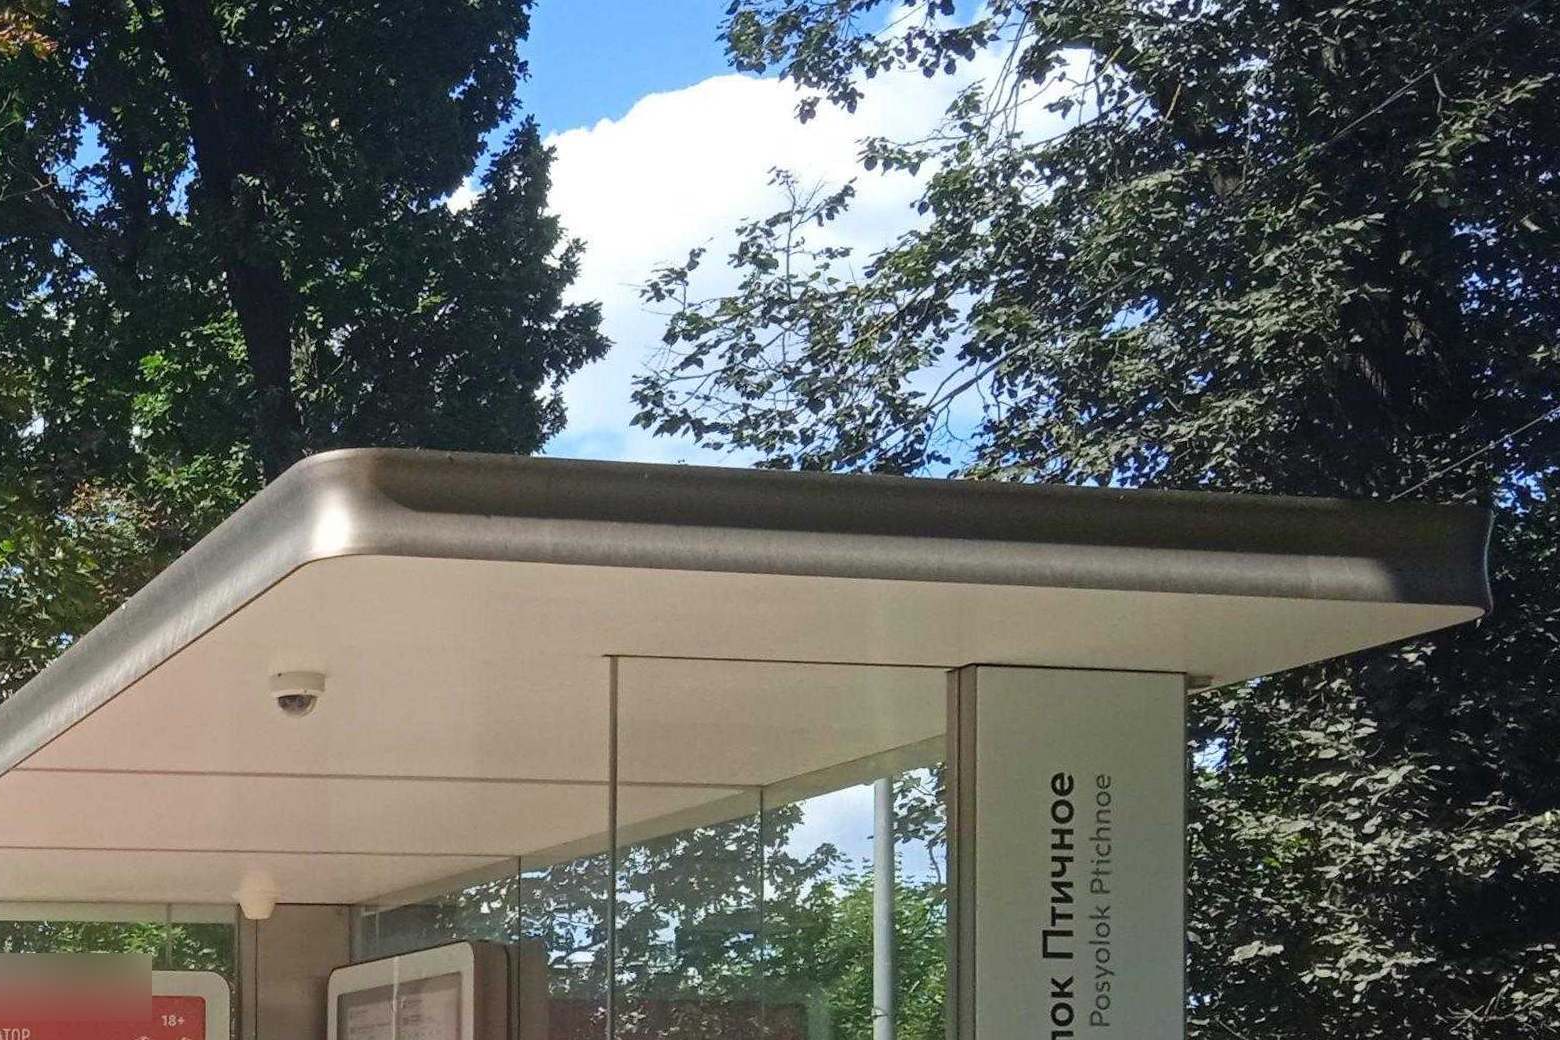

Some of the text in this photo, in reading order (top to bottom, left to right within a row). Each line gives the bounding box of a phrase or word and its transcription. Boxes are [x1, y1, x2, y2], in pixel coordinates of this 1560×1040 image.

[1042, 771, 1075, 960] Птичное
[1089, 773, 1115, 1027] Posyolok Ptichnoe
[161, 1014, 185, 1028] 18+
